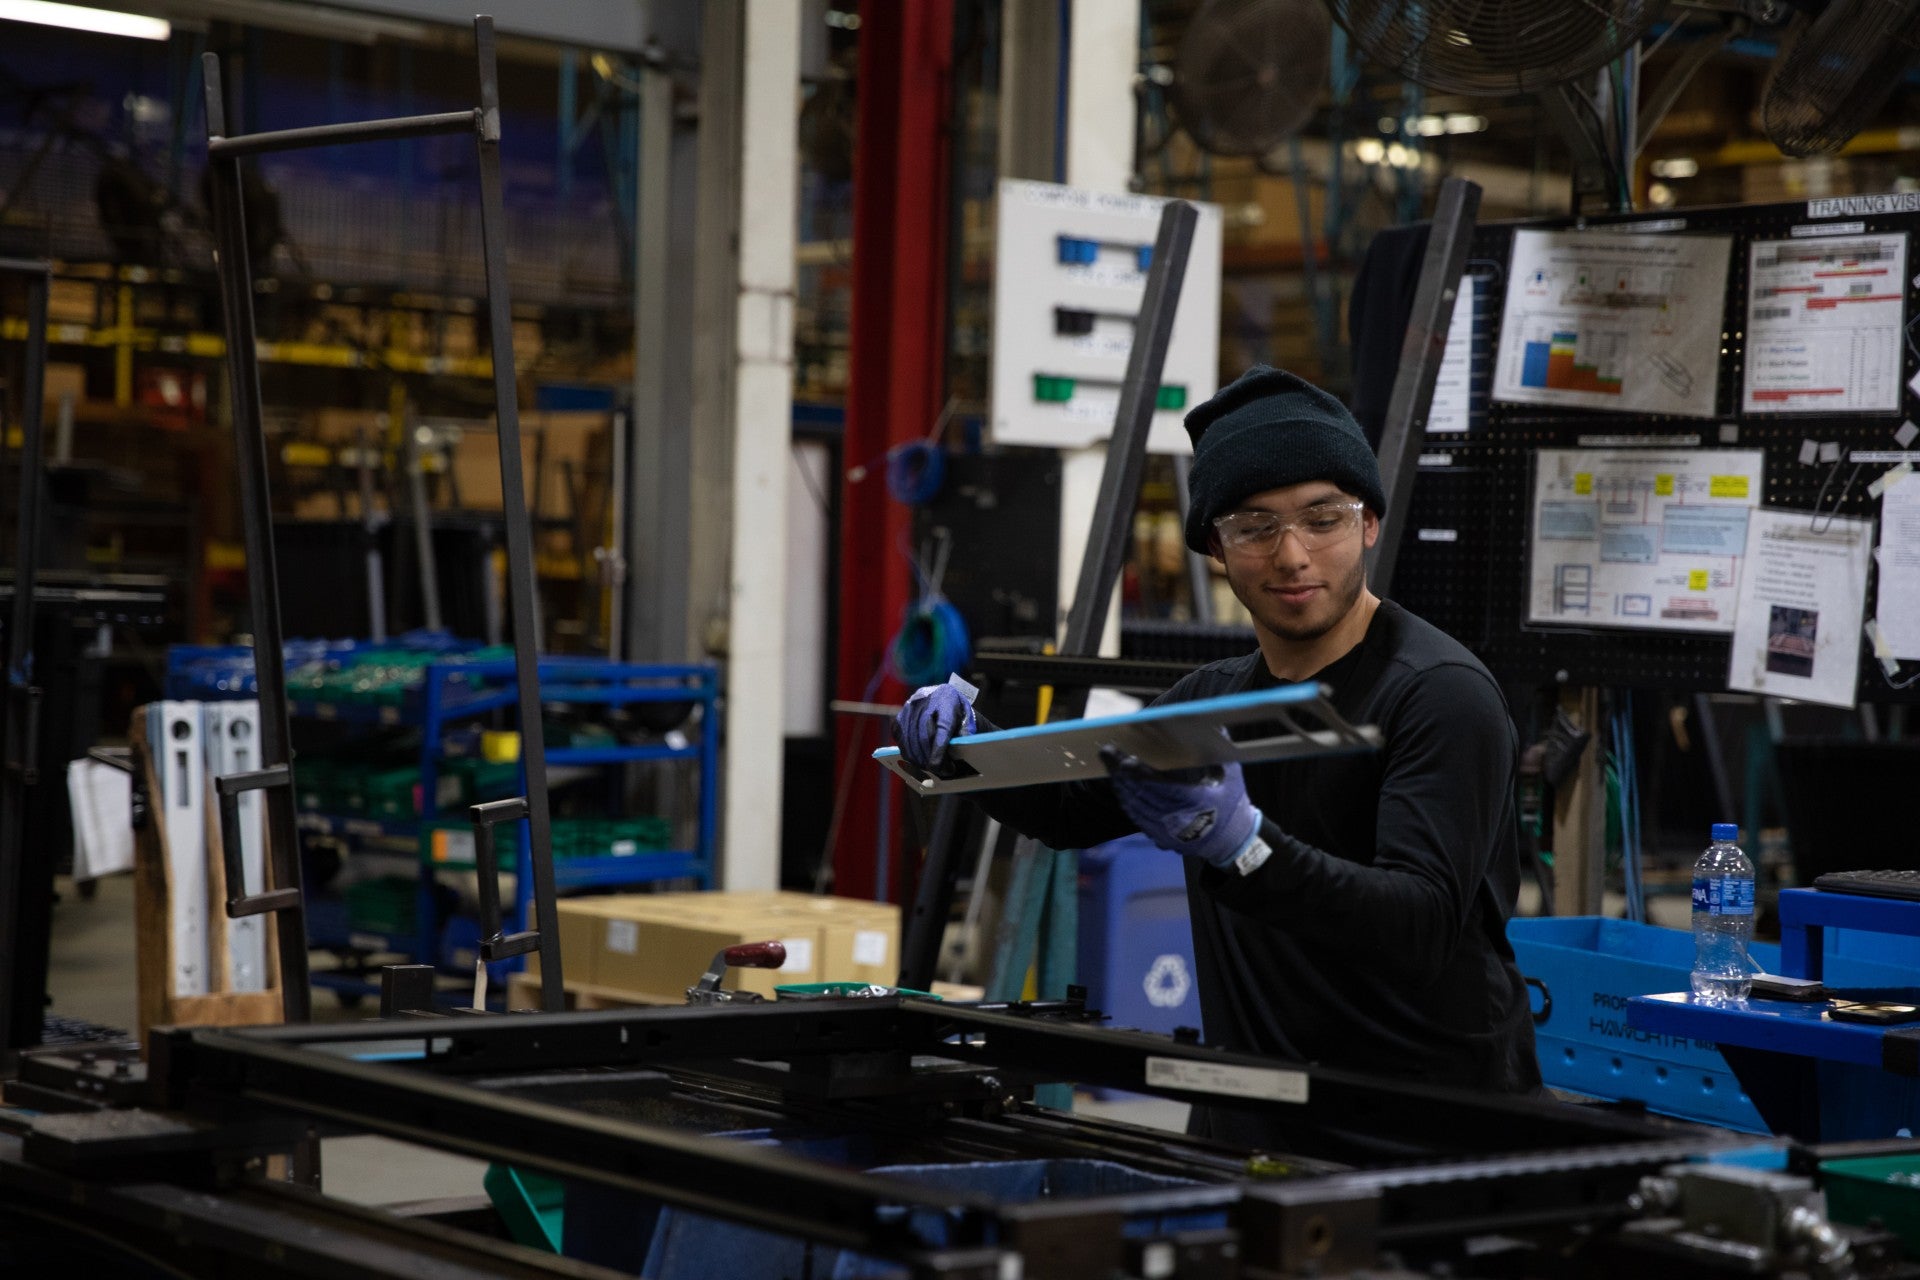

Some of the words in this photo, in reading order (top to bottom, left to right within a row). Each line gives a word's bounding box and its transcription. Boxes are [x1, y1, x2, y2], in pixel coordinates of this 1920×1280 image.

[1811, 196, 1886, 216] TRAINING
[1892, 194, 1920, 211] VIS
[1593, 992, 1628, 1011] PROP
[1589, 1017, 1689, 1051] HAWORTH
